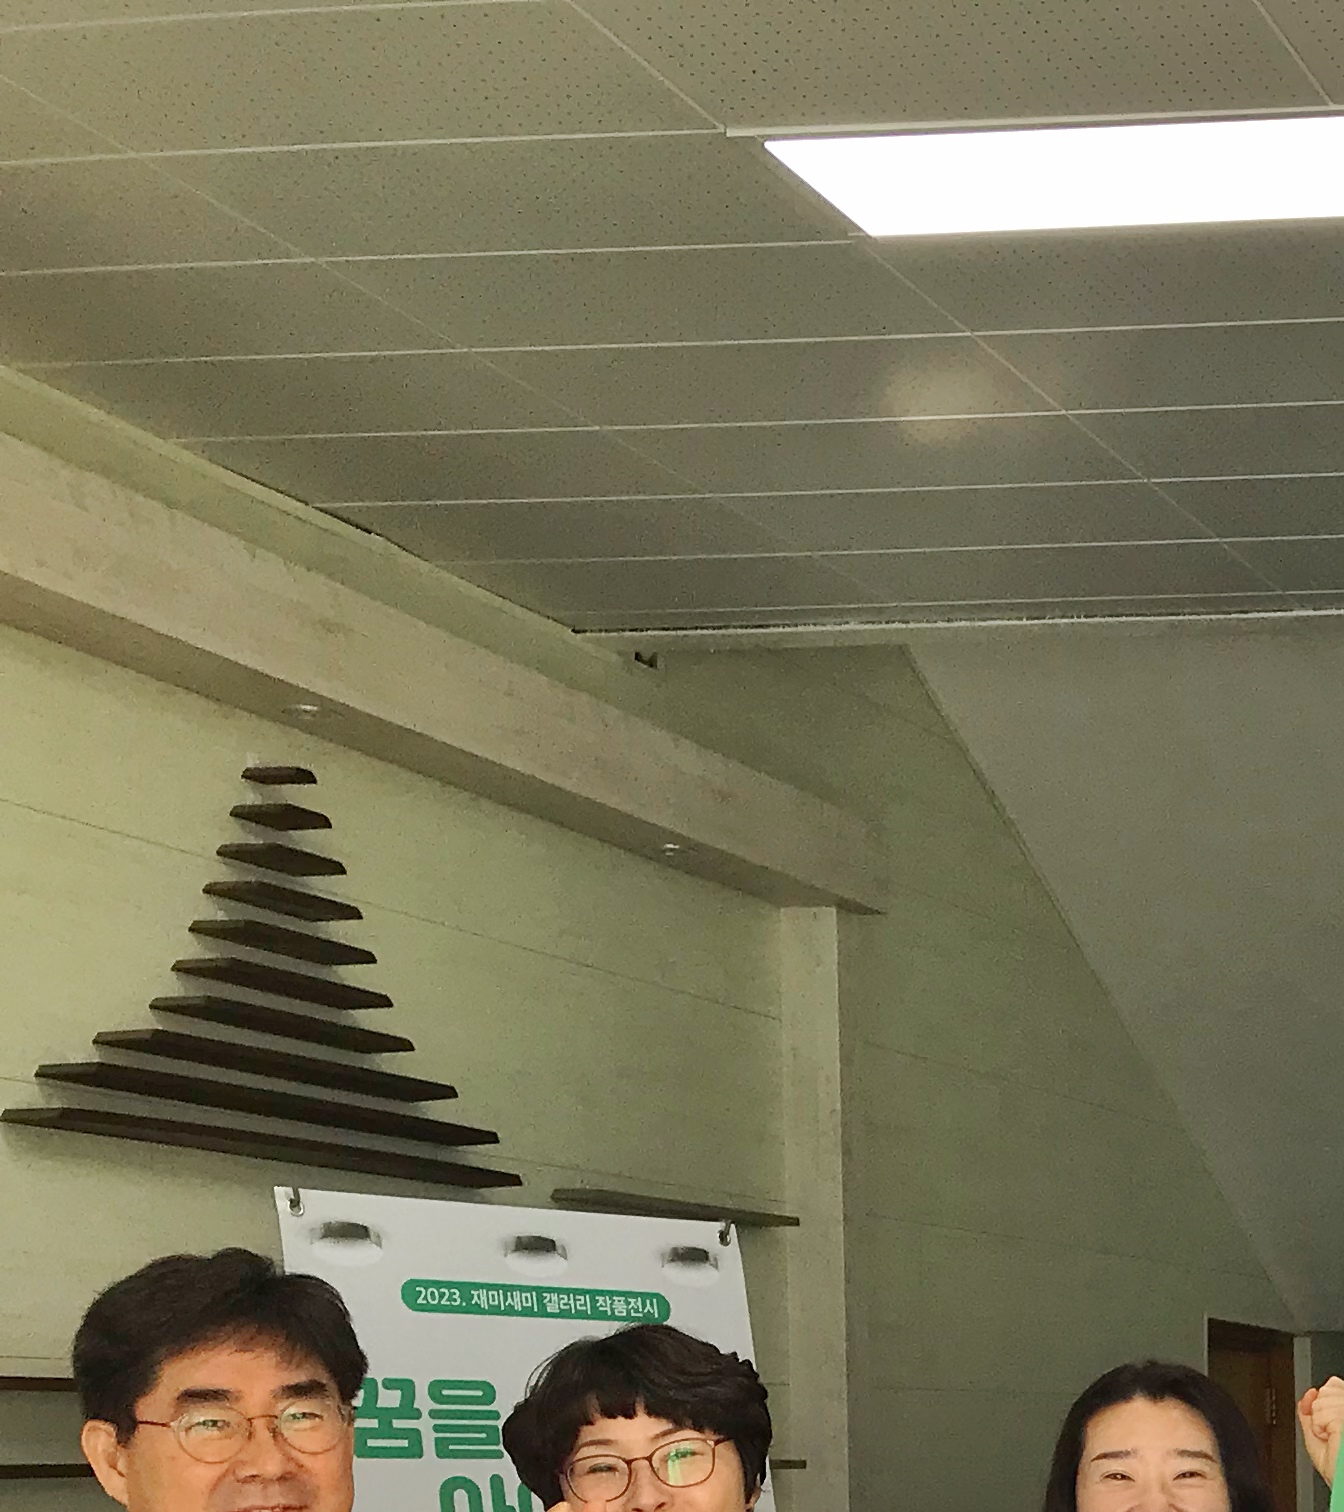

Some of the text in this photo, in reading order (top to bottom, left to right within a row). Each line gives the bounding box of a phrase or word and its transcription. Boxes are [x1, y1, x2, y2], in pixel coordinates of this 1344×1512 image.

[415, 1286, 659, 1318] 2023. 재미새미 갤러리 작품전시
[354, 1377, 504, 1459] 꿈을
